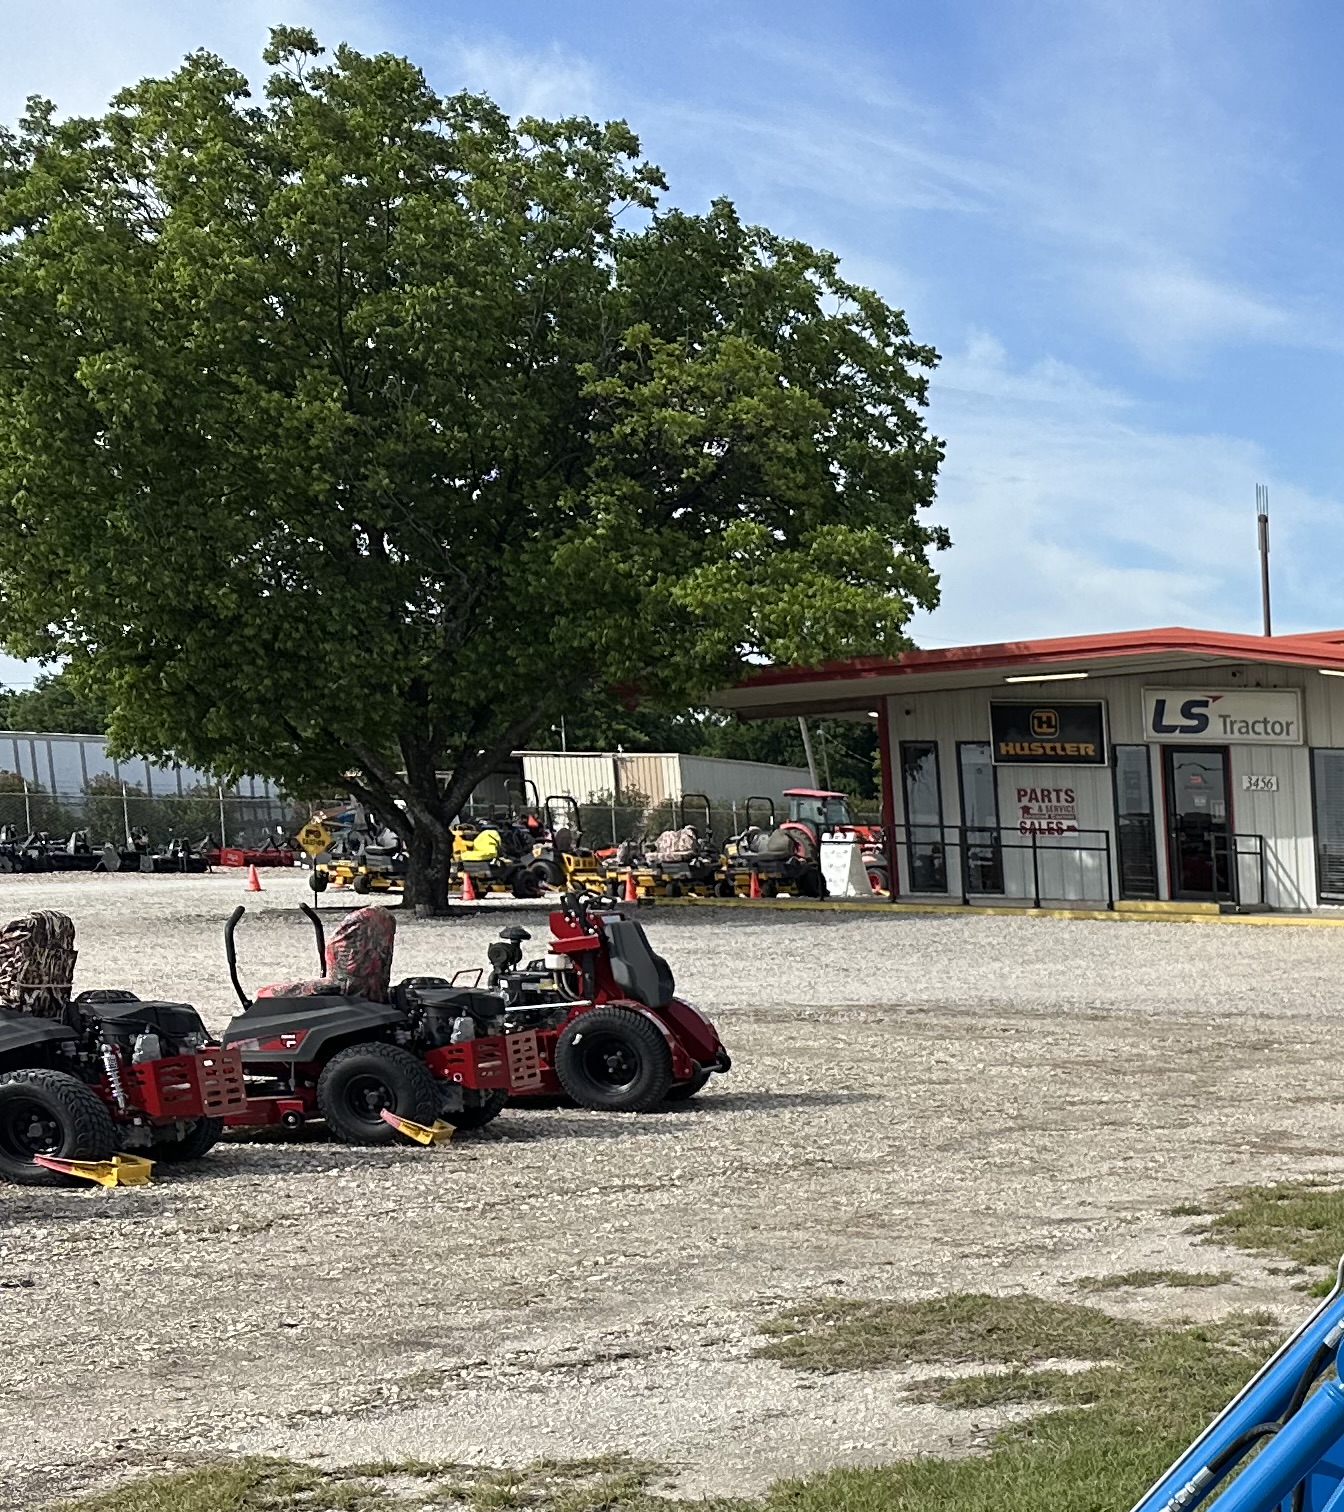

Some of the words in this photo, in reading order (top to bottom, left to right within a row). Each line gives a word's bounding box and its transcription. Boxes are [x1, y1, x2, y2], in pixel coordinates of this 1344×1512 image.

[1152, 699, 1210, 735] LS
[1218, 714, 1294, 736] Tractor
[999, 742, 1095, 756] HUSTLER
[1245, 776, 1274, 790] 3456
[1016, 788, 1075, 803] PARTS
[1019, 820, 1064, 835] SALES
